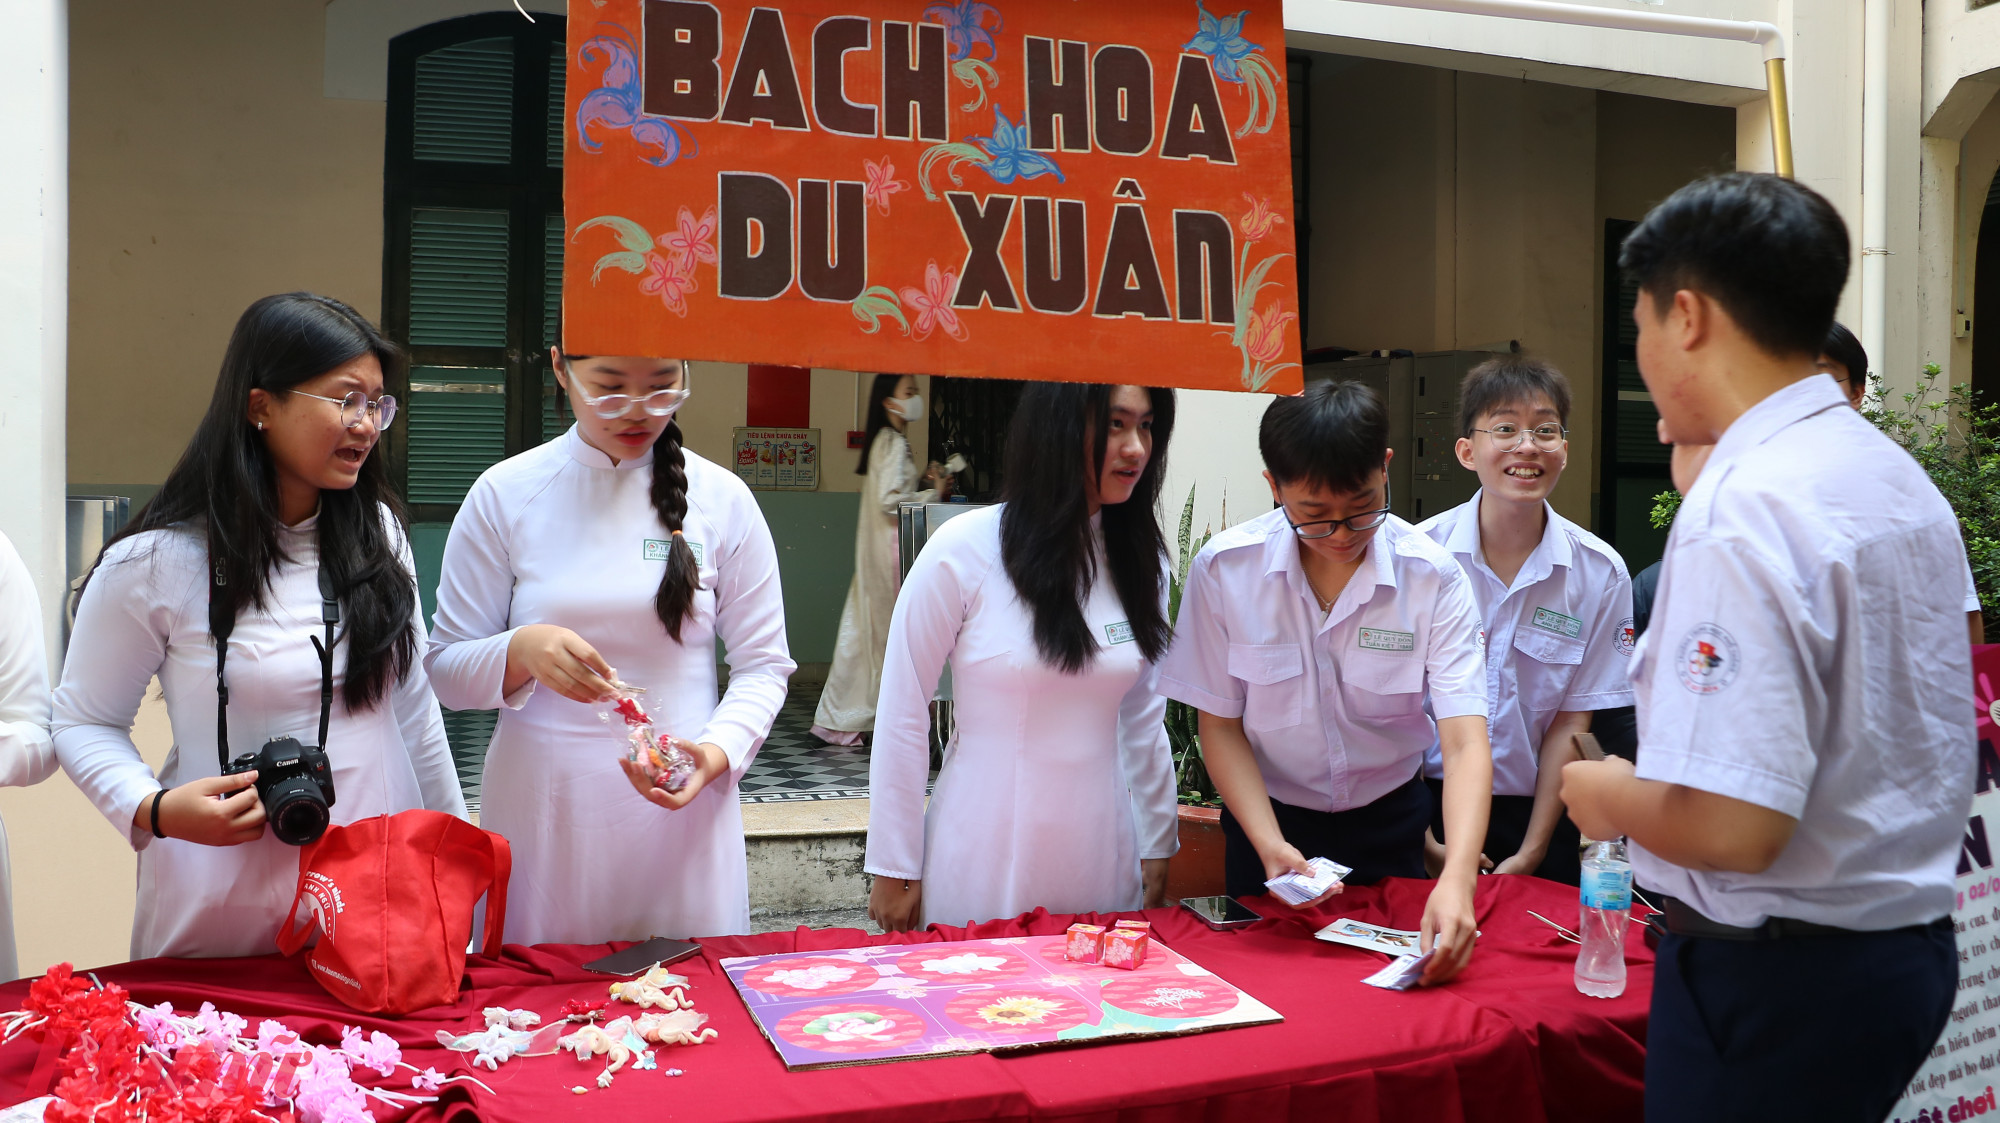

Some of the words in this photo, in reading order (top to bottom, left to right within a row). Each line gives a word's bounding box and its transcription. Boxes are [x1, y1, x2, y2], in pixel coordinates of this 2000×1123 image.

[1024, 35, 1237, 165] HOA
[717, 171, 867, 303] DU
[946, 178, 1237, 325] XUÂN
[276, 758, 299, 767] Canon
[1957, 815, 1992, 875] N
[305, 871, 335, 888] rrow's
[1969, 876, 2000, 900] 02/0
